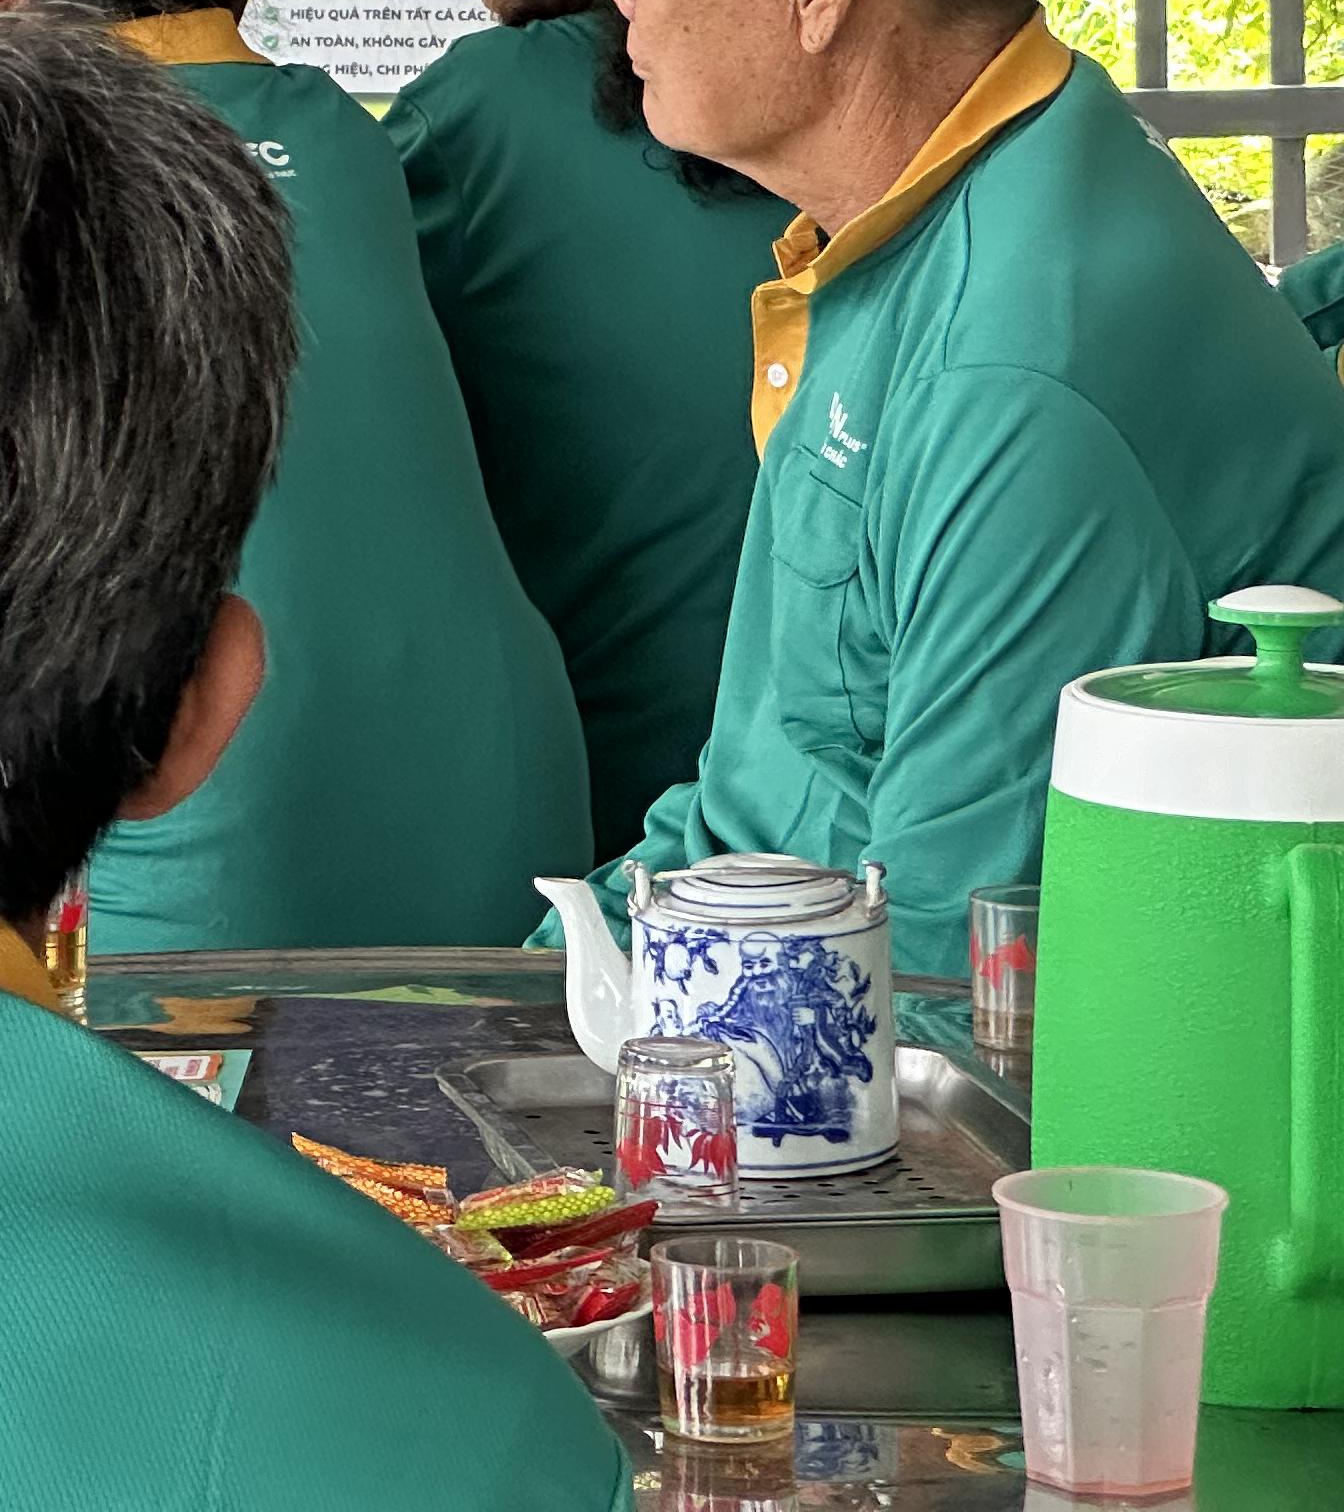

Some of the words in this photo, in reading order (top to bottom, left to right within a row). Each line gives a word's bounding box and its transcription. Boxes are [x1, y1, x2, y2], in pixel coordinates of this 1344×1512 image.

[290, 6, 324, 22] HIỆU
[328, 5, 359, 22] QUẢ
[363, 6, 401, 21] TRÊN
[406, 5, 431, 21] TẤT
[458, 7, 487, 22] CÁC
[290, 36, 311, 48] AN
[315, 34, 359, 49] TOÀN,
[363, 34, 414, 48] KHÔNG
[335, 61, 373, 78] HIỆU,
[376, 64, 400, 76] CHI
